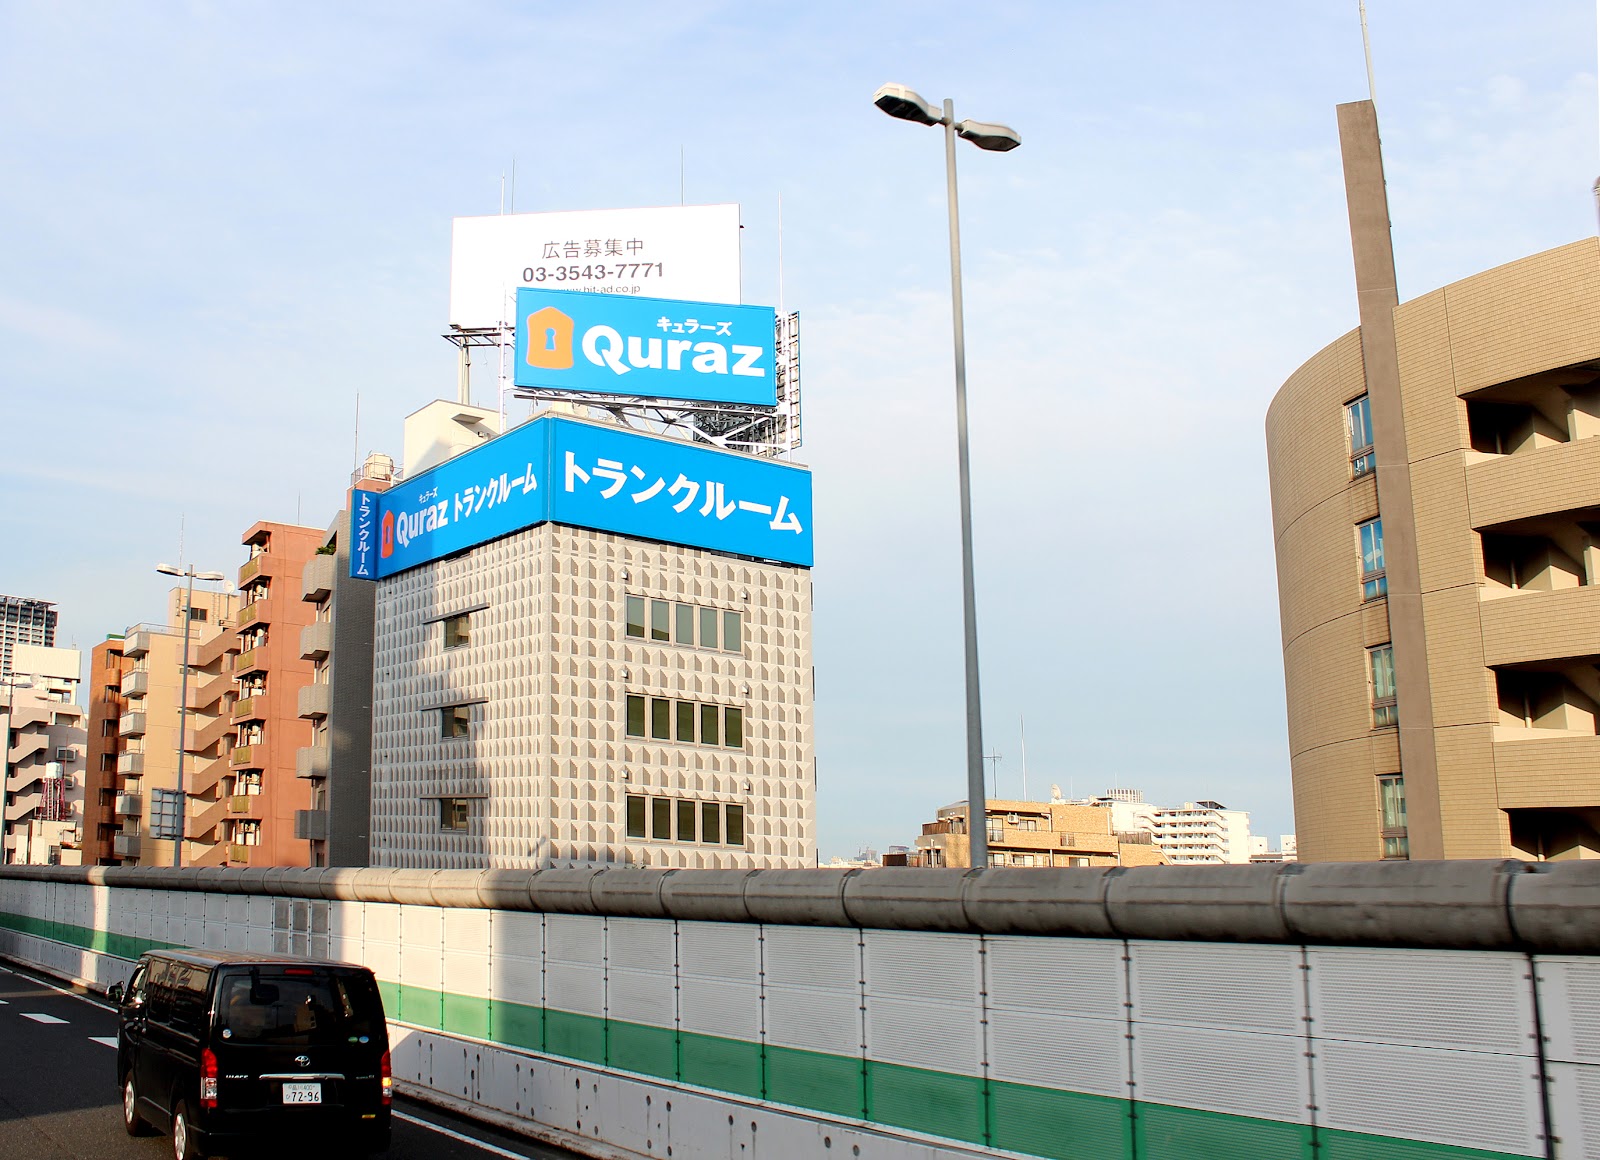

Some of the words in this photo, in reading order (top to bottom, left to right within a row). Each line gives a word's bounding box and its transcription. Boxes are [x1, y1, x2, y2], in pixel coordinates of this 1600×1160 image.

[542, 237, 643, 259] 広告募集中
[522, 262, 663, 282] 03-3543-7771
[656, 316, 732, 336] キュラーズ
[581, 324, 766, 377] Quraz
[396, 499, 449, 548] Quraz
[454, 462, 538, 523] トランクルーム
[564, 450, 803, 535] トランクルーム
[356, 493, 371, 576] トランクルーム
[291, 1091, 320, 1102] 72-96
